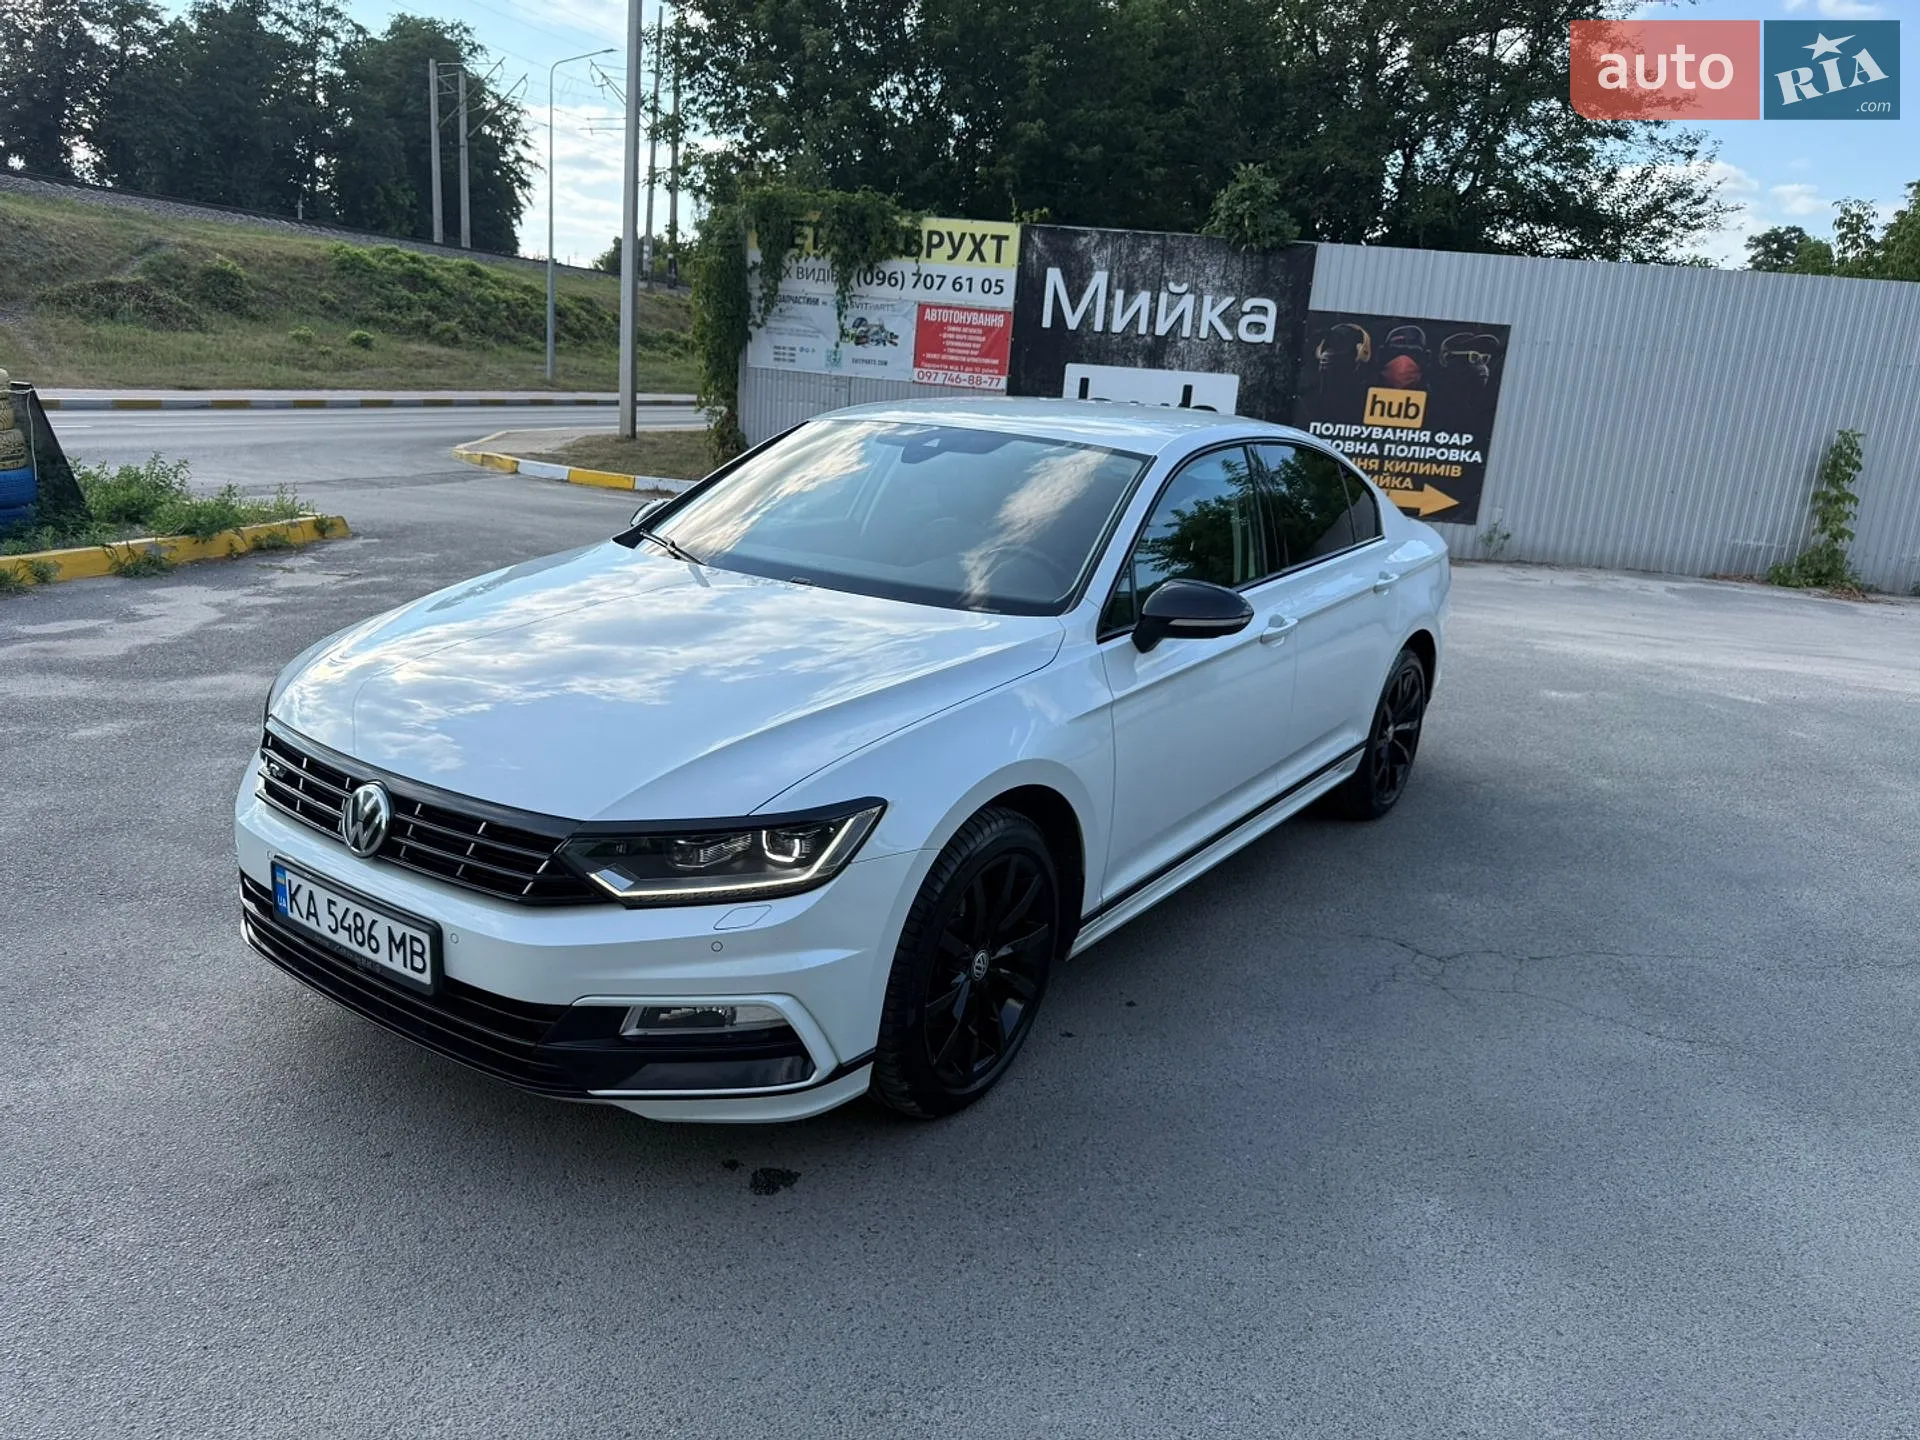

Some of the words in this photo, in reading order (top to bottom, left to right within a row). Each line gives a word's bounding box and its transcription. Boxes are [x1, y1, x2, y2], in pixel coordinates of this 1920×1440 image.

[856, 269, 905, 291] (096)
[912, 272, 946, 293] 707
[952, 276, 973, 294] 61
[981, 277, 1005, 295] 05
[924, 308, 1004, 328] АВТОТОНУВАННЯ
[1041, 266, 1278, 345] Мийка
[917, 370, 939, 381] 097
[941, 372, 1002, 388] 746-88-77
[1369, 394, 1421, 421] hub
[1309, 422, 1431, 444] ПОЛІРУВАННЯ
[1434, 431, 1473, 447] ФАР
[1383, 444, 1483, 463] ПОЛІРОВКА
[1383, 460, 1463, 478] КИЛИМІВ
[288, 878, 320, 928] KA
[326, 898, 381, 955] 5486
[387, 925, 427, 975] MB
